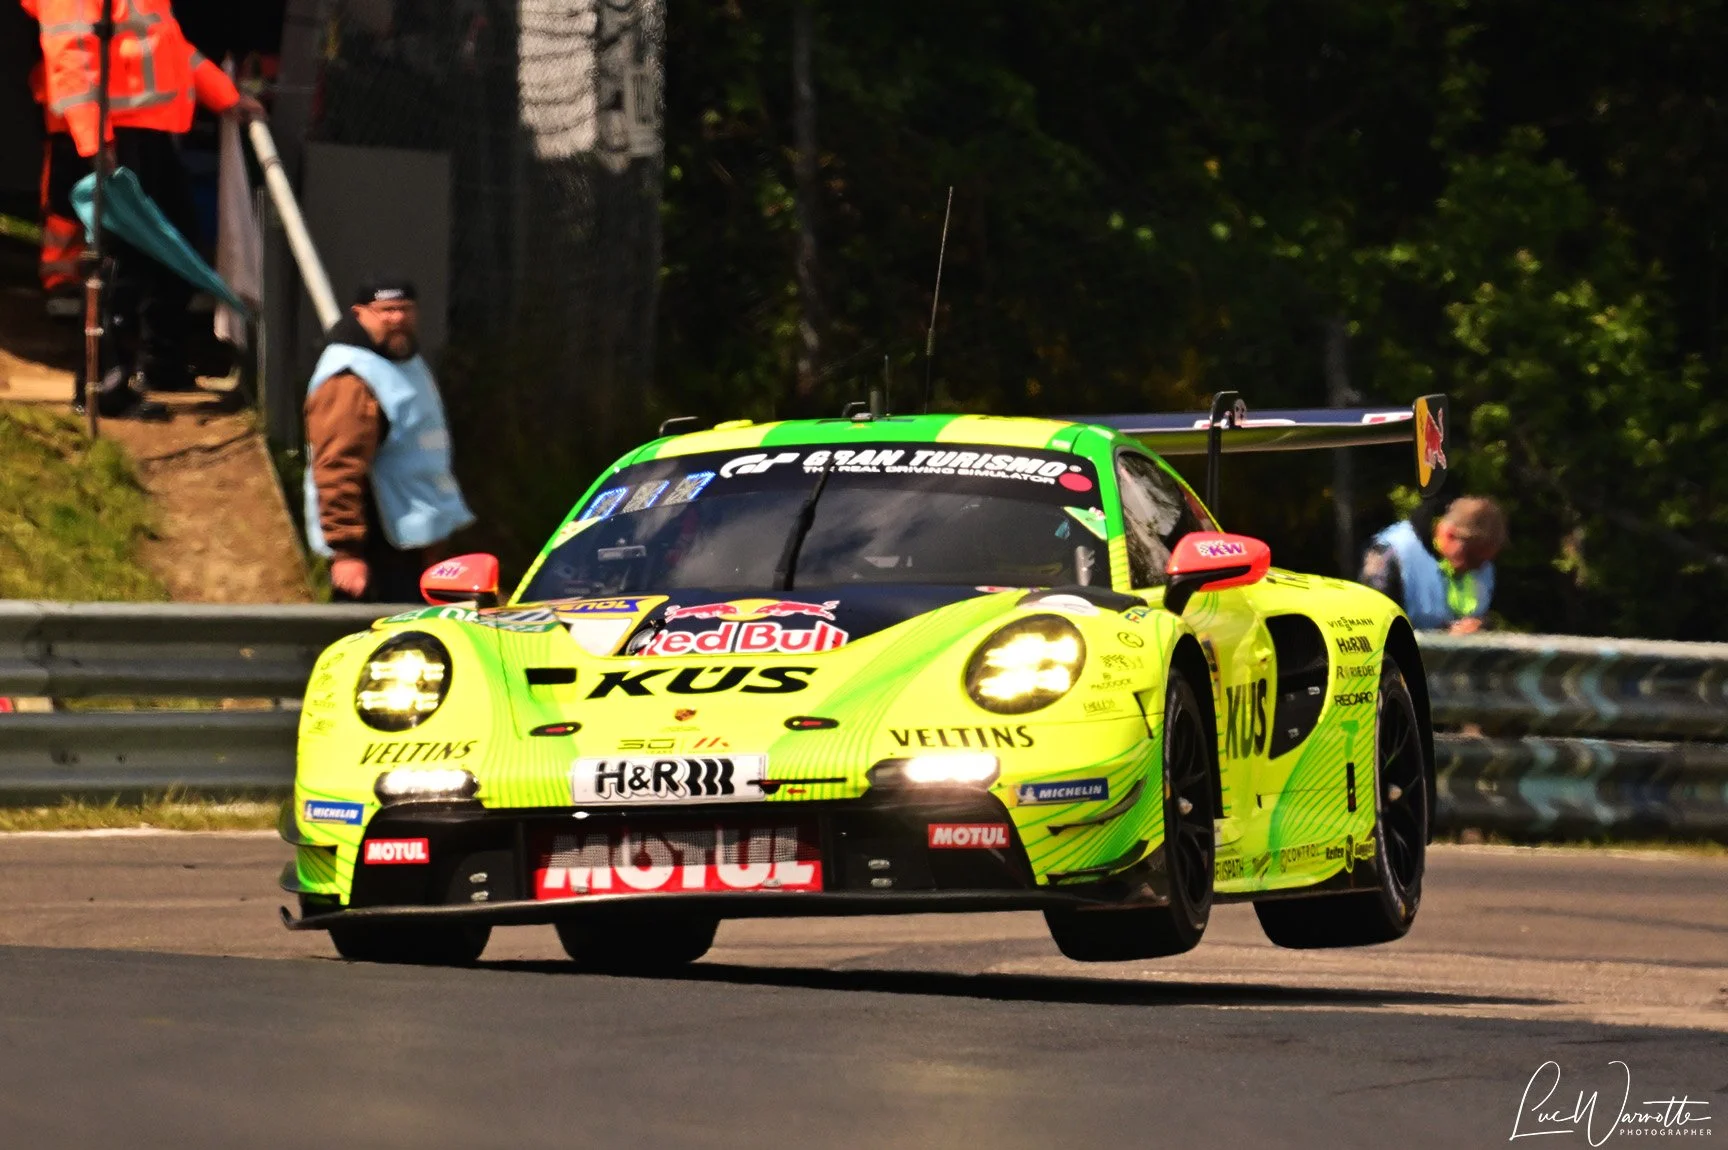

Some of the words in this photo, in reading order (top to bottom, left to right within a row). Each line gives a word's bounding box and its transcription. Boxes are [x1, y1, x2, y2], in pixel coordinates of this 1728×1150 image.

[802, 449, 905, 467] GRAN
[909, 450, 1068, 478] TURISMO
[838, 465, 881, 473] REAL
[884, 465, 955, 475] DRIVING
[957, 468, 1055, 485] SIMULATOR
[1208, 543, 1242, 556] KW
[637, 621, 735, 656] Red
[737, 620, 849, 654] Bull
[585, 666, 818, 700] KÜS
[1334, 691, 1374, 706] RECARO
[890, 725, 1035, 749] VELTINS
[360, 740, 479, 765] VELTINS
[594, 759, 686, 798] H&R
[1038, 785, 1103, 799] MICHELIN
[312, 806, 360, 820] MICHELIN
[932, 826, 1007, 846] MOTUL
[367, 841, 427, 861] MOTUL
[543, 825, 815, 890] MOTUL
